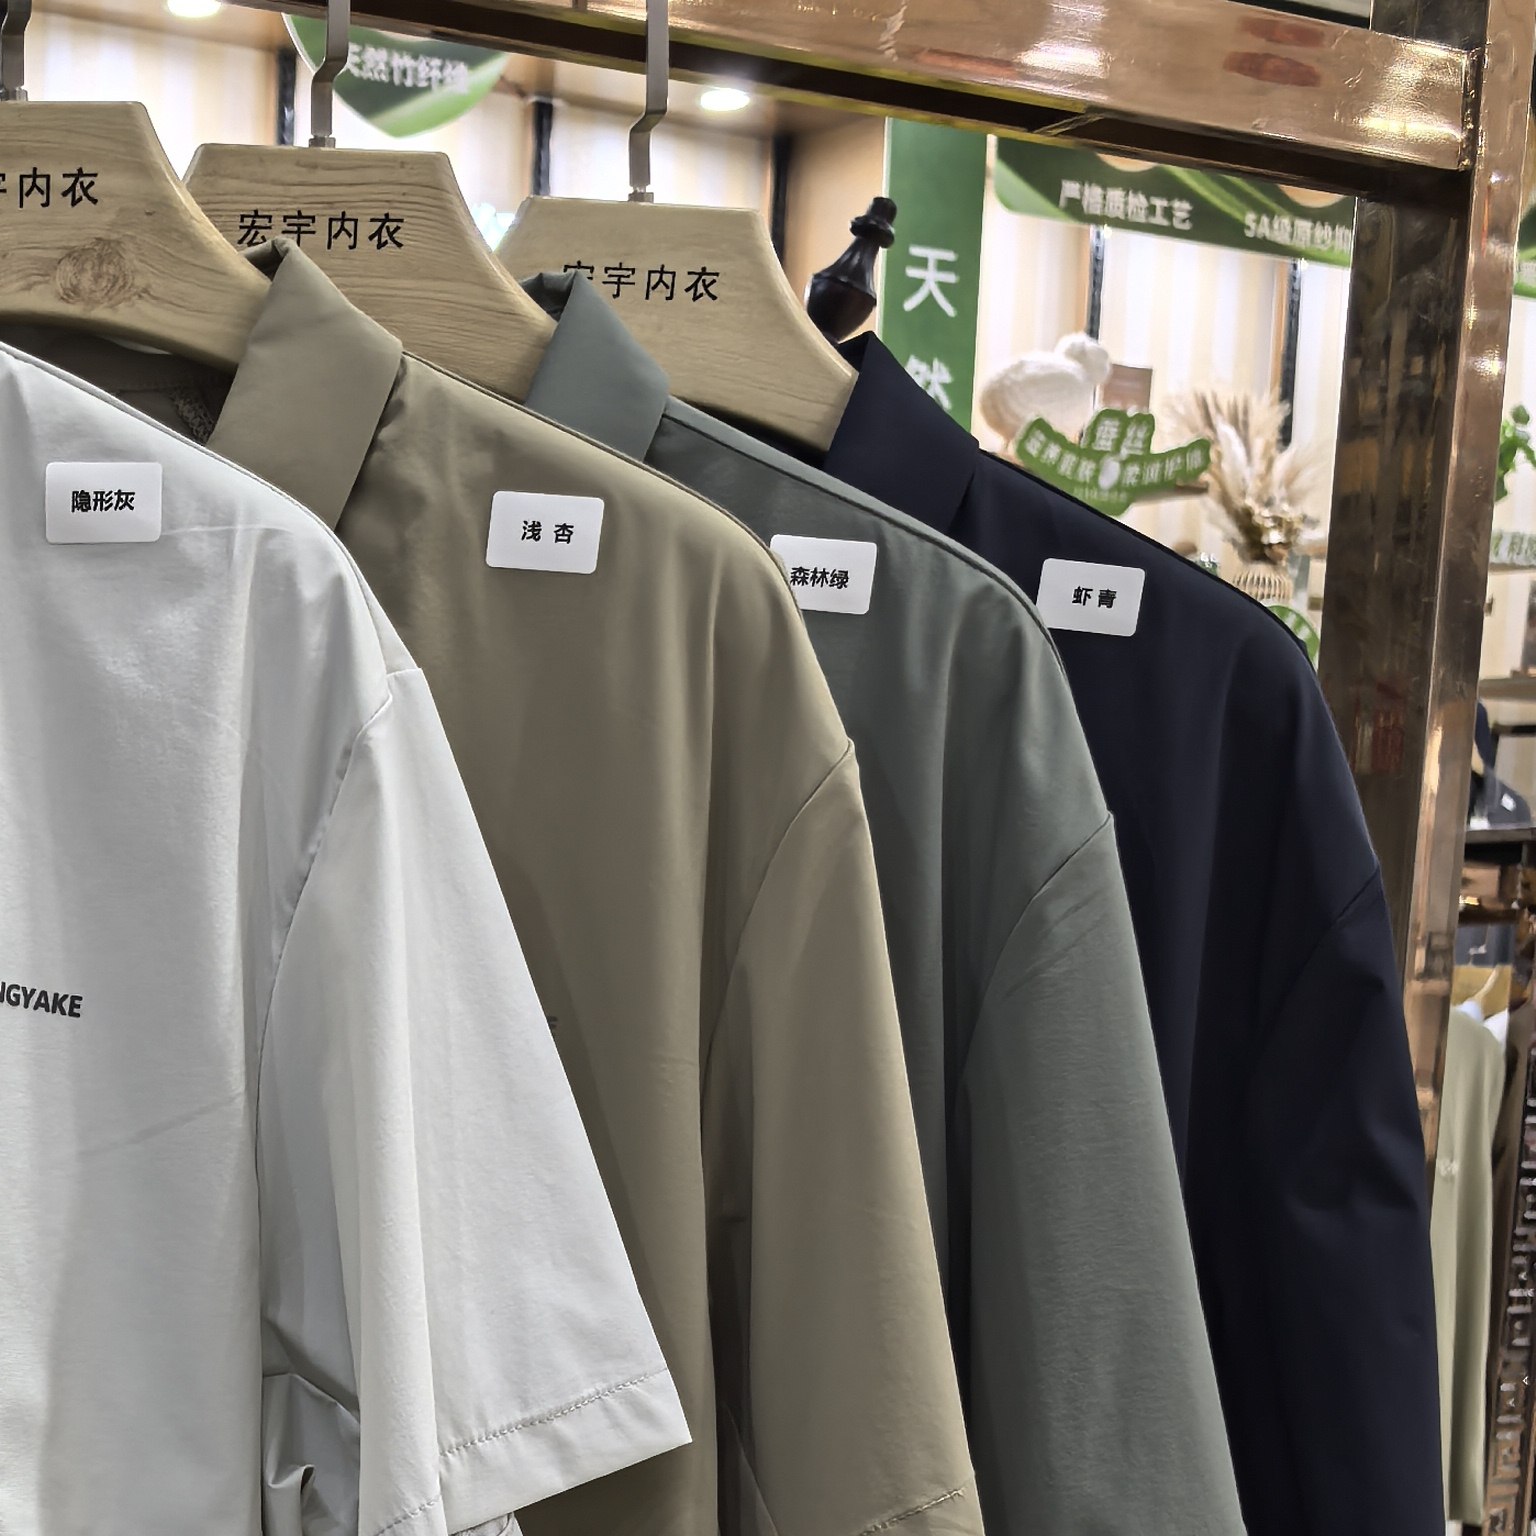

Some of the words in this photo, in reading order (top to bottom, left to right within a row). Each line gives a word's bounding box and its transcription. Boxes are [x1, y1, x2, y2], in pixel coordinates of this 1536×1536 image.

[237, 209, 405, 251] 宏宇内衣
[71, 488, 136, 513] 隐形灰
[789, 566, 850, 590] 森林绿
